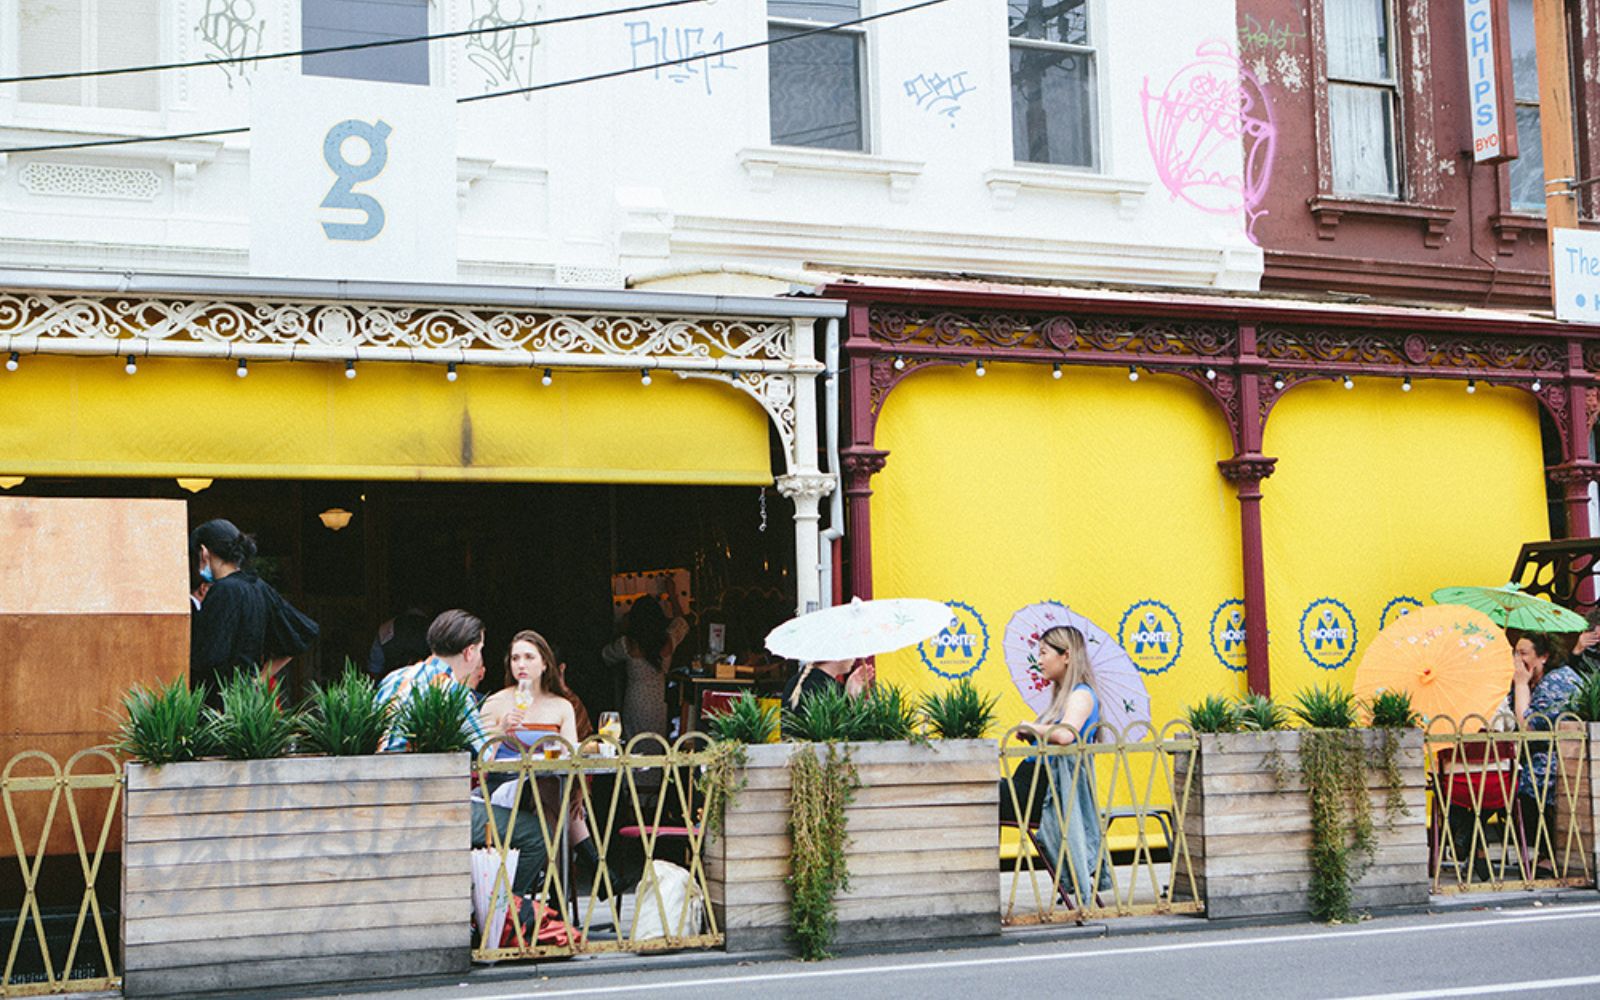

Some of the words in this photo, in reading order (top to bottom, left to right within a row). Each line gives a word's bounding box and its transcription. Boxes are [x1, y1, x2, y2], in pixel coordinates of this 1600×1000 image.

[1469, 11, 1493, 126] CHIPS
[1475, 133, 1499, 152] BYO
[1566, 247, 1600, 276] The
